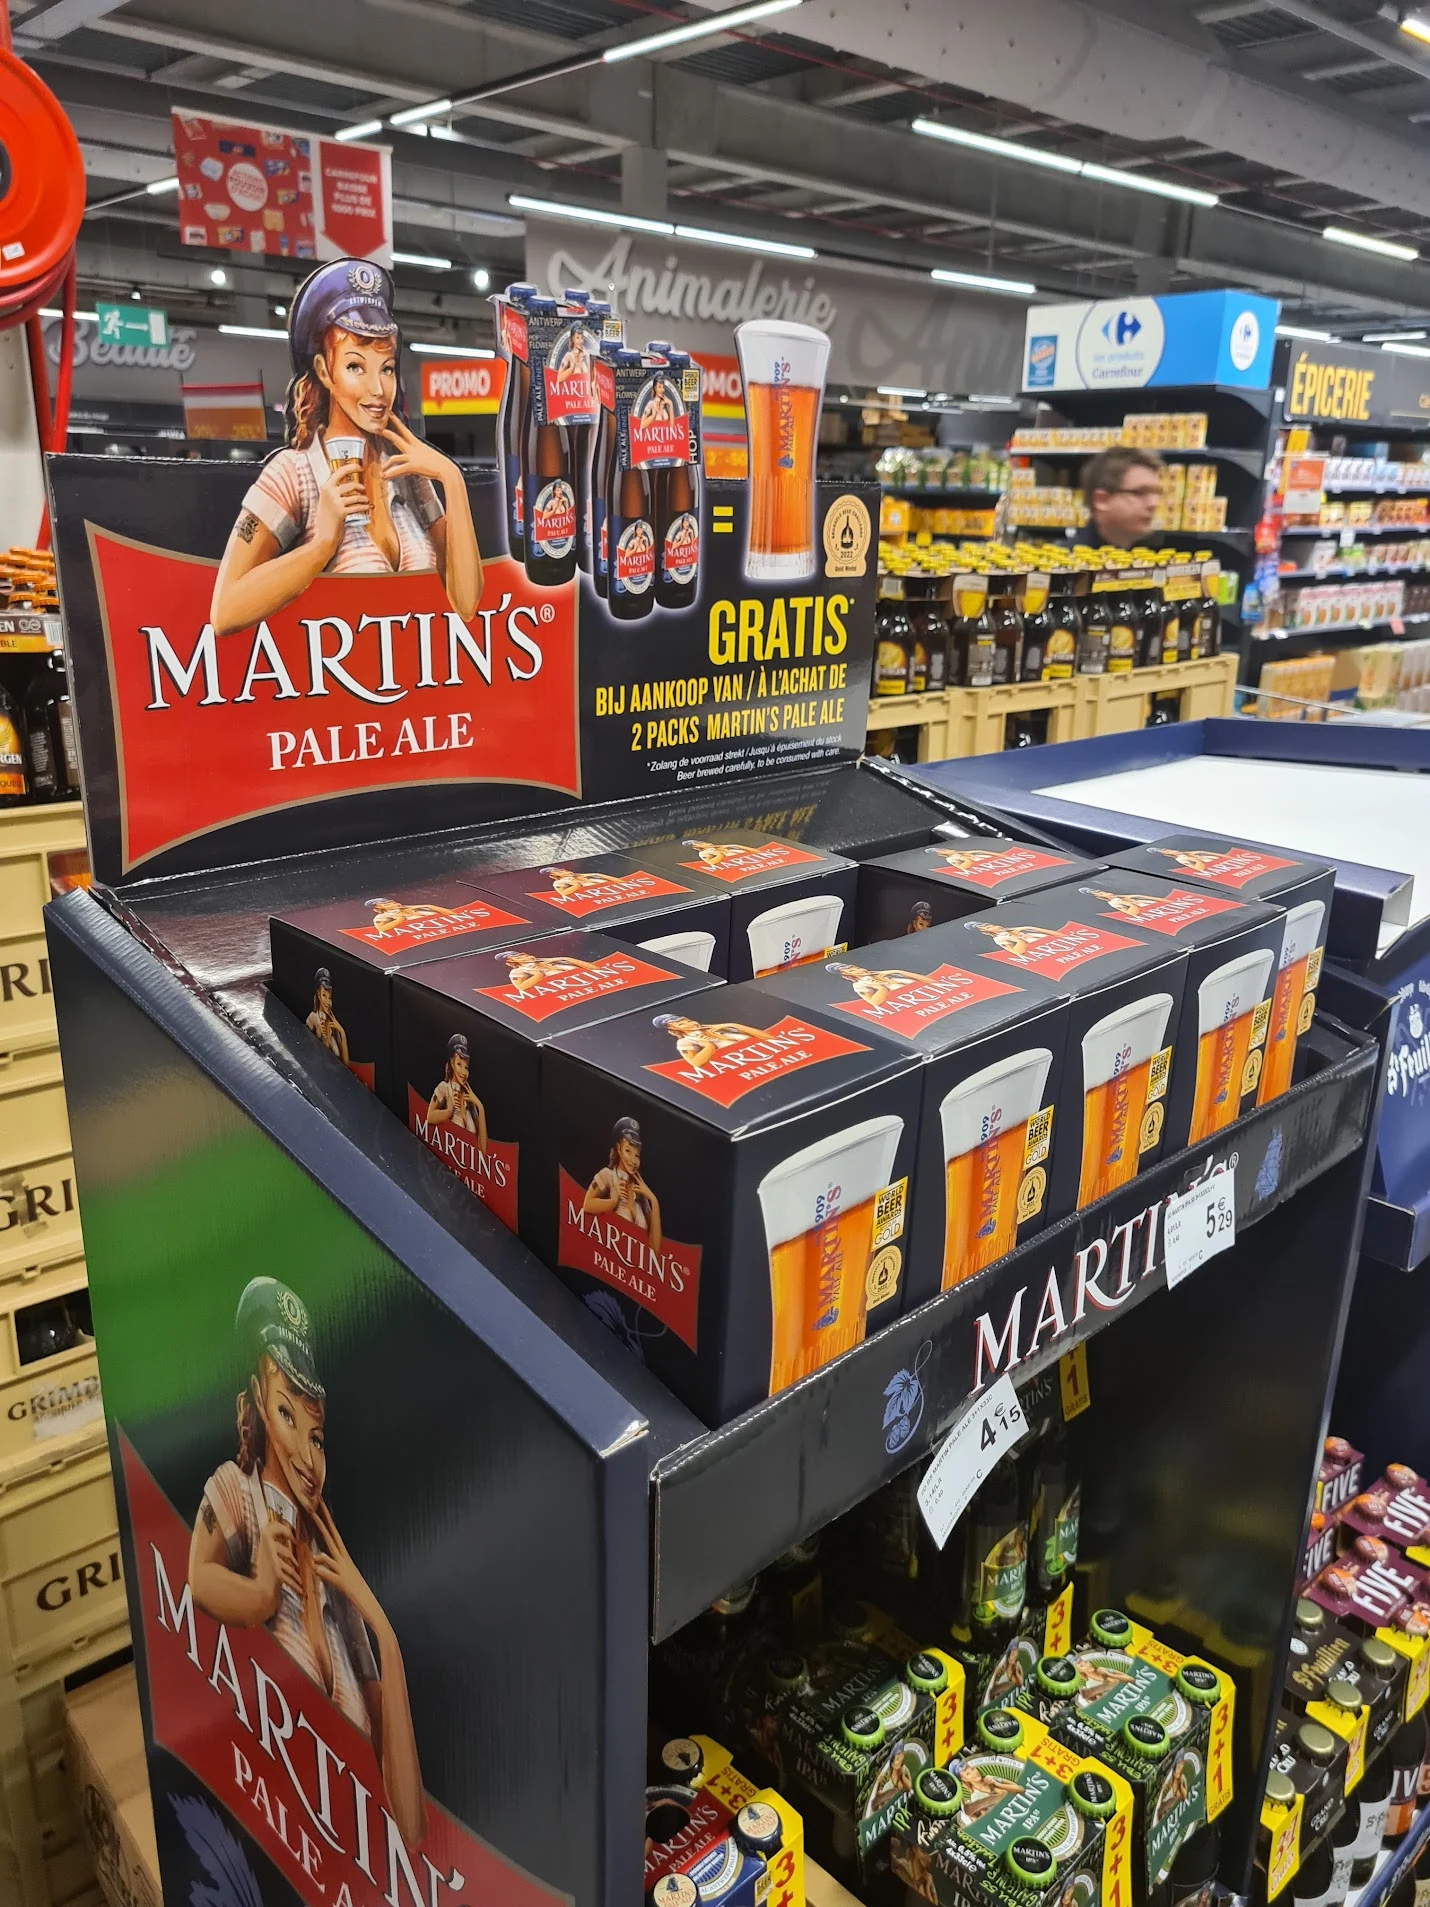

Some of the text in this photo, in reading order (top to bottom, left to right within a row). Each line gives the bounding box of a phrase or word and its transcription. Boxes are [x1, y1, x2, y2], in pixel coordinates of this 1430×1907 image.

[547, 236, 839, 335] Animalerie
[528, 317, 563, 327] ANTWERP
[429, 371, 491, 397] PROMO
[615, 369, 647, 378] ANTWERP
[684, 378, 698, 387] BEER
[1091, 365, 1143, 380] Carrefour
[1290, 352, 1376, 421] ÉPICERIE
[633, 424, 685, 444] MARTIN'S
[688, 430, 698, 464] HOP
[647, 444, 675, 454] PALE ALE
[840, 551, 853, 559] 2022
[140, 592, 544, 711] MARTIN'S
[596, 685, 625, 716] BIJ
[630, 677, 708, 713] AANKOOP
[712, 673, 743, 703] VAN
[757, 665, 768, 698] À
[771, 665, 826, 697] L'ACHAT
[829, 663, 847, 690] DE
[631, 698, 845, 751] 2 PACKS MARTIN'S PALE ALE
[267, 711, 475, 771] PALE ALE
[678, 756, 689, 768] de
[690, 751, 724, 765] voorraad
[724, 748, 745, 761] strekt
[815, 737, 825, 747] du
[824, 734, 842, 745] stock
[677, 770, 696, 781] Beer
[696, 763, 724, 777] brewed
[765, 756, 775, 767] be
[775, 750, 811, 765] consumed
[810, 747, 825, 759] with
[700, 847, 790, 873] MARTIN'S
[942, 849, 1037, 879] MARTIN'S
[1192, 853, 1263, 880] MARTIN'S
[549, 876, 657, 907] MARTIN'S
[592, 889, 651, 906] PALE ALE
[1124, 894, 1205, 925] MARTIN'S
[364, 907, 492, 942] MARTIN'S
[411, 920, 479, 941] PALE ALE
[1006, 928, 1100, 967] MARTIN'S
[503, 960, 637, 1004] MARTIN'S
[557, 976, 629, 1002] PALE ALE
[860, 974, 974, 1020] MARTIN'S
[913, 990, 974, 1018] PALE ALE
[1254, 1012, 1268, 1027] BEER
[1250, 1032, 1265, 1047] GOLD
[677, 1028, 816, 1084] MARTIN'S
[737, 1049, 813, 1081] PALE ALE
[1151, 1061, 1168, 1077] BEER
[1152, 1051, 1170, 1067] WORLD
[1147, 1084, 1165, 1100] GOLD
[1028, 1120, 1049, 1139] BEER
[1029, 1111, 1051, 1129] WORLD
[414, 1111, 507, 1188] MARTIN'S
[1028, 1132, 1049, 1148] AWARDS
[1025, 1146, 1047, 1166] GOLD
[877, 1195, 903, 1218] BEER
[878, 1182, 905, 1205] WORLD
[876, 1208, 902, 1226] AWARDS
[567, 1200, 685, 1293] MARTIN'S
[817, 1185, 843, 1310] MARTIN'S
[874, 1223, 901, 1246] GOLD
[593, 1250, 657, 1303] PALE ALE
[1063, 1394, 1089, 1415] GRATIS
[932, 1418, 972, 1475] MARTIN PALE ALE
[1321, 1462, 1361, 1513] FIVE
[1384, 1486, 1430, 1538] FIVE
[1303, 1527, 1334, 1579] IVE
[37, 1552, 122, 1612] GRI
[1352, 1560, 1415, 1617] FIVE
[1147, 1639, 1185, 1664] GRATIS
[1096, 1665, 1158, 1725] MARTIN'S
[150, 1542, 467, 1907] MARTIN'
[1374, 1723, 1390, 1742] CRU
[1040, 1737, 1081, 1767] GRATIS
[1277, 1754, 1297, 1774] CRU
[721, 1766, 756, 1798] GRATIS
[929, 1771, 953, 1800] MARTIN'S
[979, 1771, 1050, 1847] MARTIN'S
[1208, 1788, 1232, 1816] GRATIS
[1311, 1797, 1334, 1821] GRAND
[231, 1740, 326, 1895] PALE
[893, 1803, 912, 1832] IPA
[1150, 1782, 1201, 1854] MARTIN'S
[1314, 1812, 1329, 1831] CRU
[1013, 1845, 1051, 1860] MARTIN'S
[708, 1869, 730, 1892] ANTWERP
[979, 1878, 998, 1894] 55
[657, 1888, 696, 1906] MARTIN'S
